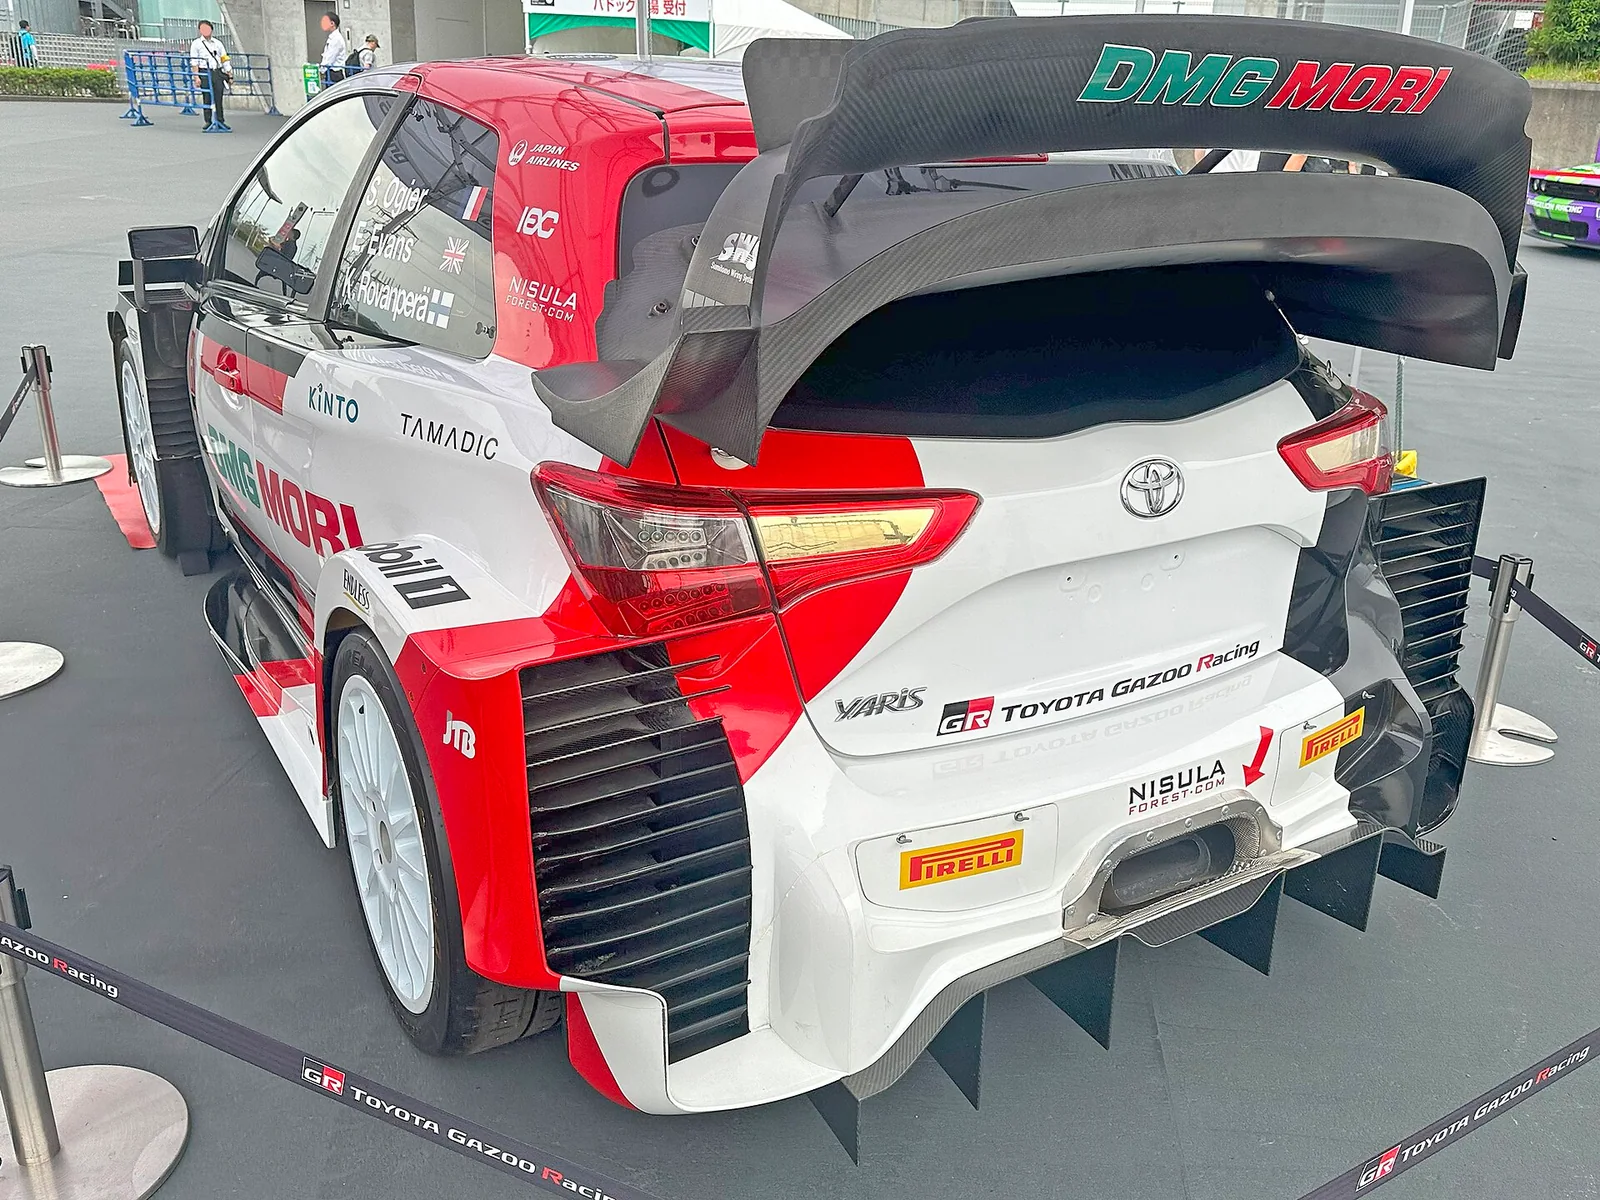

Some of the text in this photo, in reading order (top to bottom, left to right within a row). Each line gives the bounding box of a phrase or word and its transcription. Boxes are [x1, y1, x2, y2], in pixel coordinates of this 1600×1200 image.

[594, 0, 686, 16] パドック場 受付
[1076, 43, 1453, 114] DMG MORI
[526, 156, 580, 171] AIRLINES
[530, 144, 566, 155] JAPAN
[384, 177, 429, 215] Ogier
[368, 223, 414, 263] Evans
[717, 232, 760, 270] SW
[358, 271, 430, 322] Rovanperä
[509, 276, 577, 310] NISULA
[401, 412, 498, 460] TAMADIC
[208, 423, 364, 557] DMG MORI
[356, 541, 444, 579] obil
[343, 568, 370, 609] ENDLESS
[938, 640, 1260, 736] GR TOYOTA GAZOO Racing
[443, 710, 476, 759] JTB
[1305, 714, 1362, 761] PIRELLI
[1129, 759, 1226, 805] NISULA
[909, 836, 1017, 882] PIRELLI
[0, 936, 119, 998] AZOO Racing
[303, 1063, 343, 1095] GR
[350, 1086, 440, 1135] TOYOTA
[447, 1128, 536, 1174] GAZOO
[1359, 1046, 1590, 1189] GR TOYOTA GAZOO Racing
